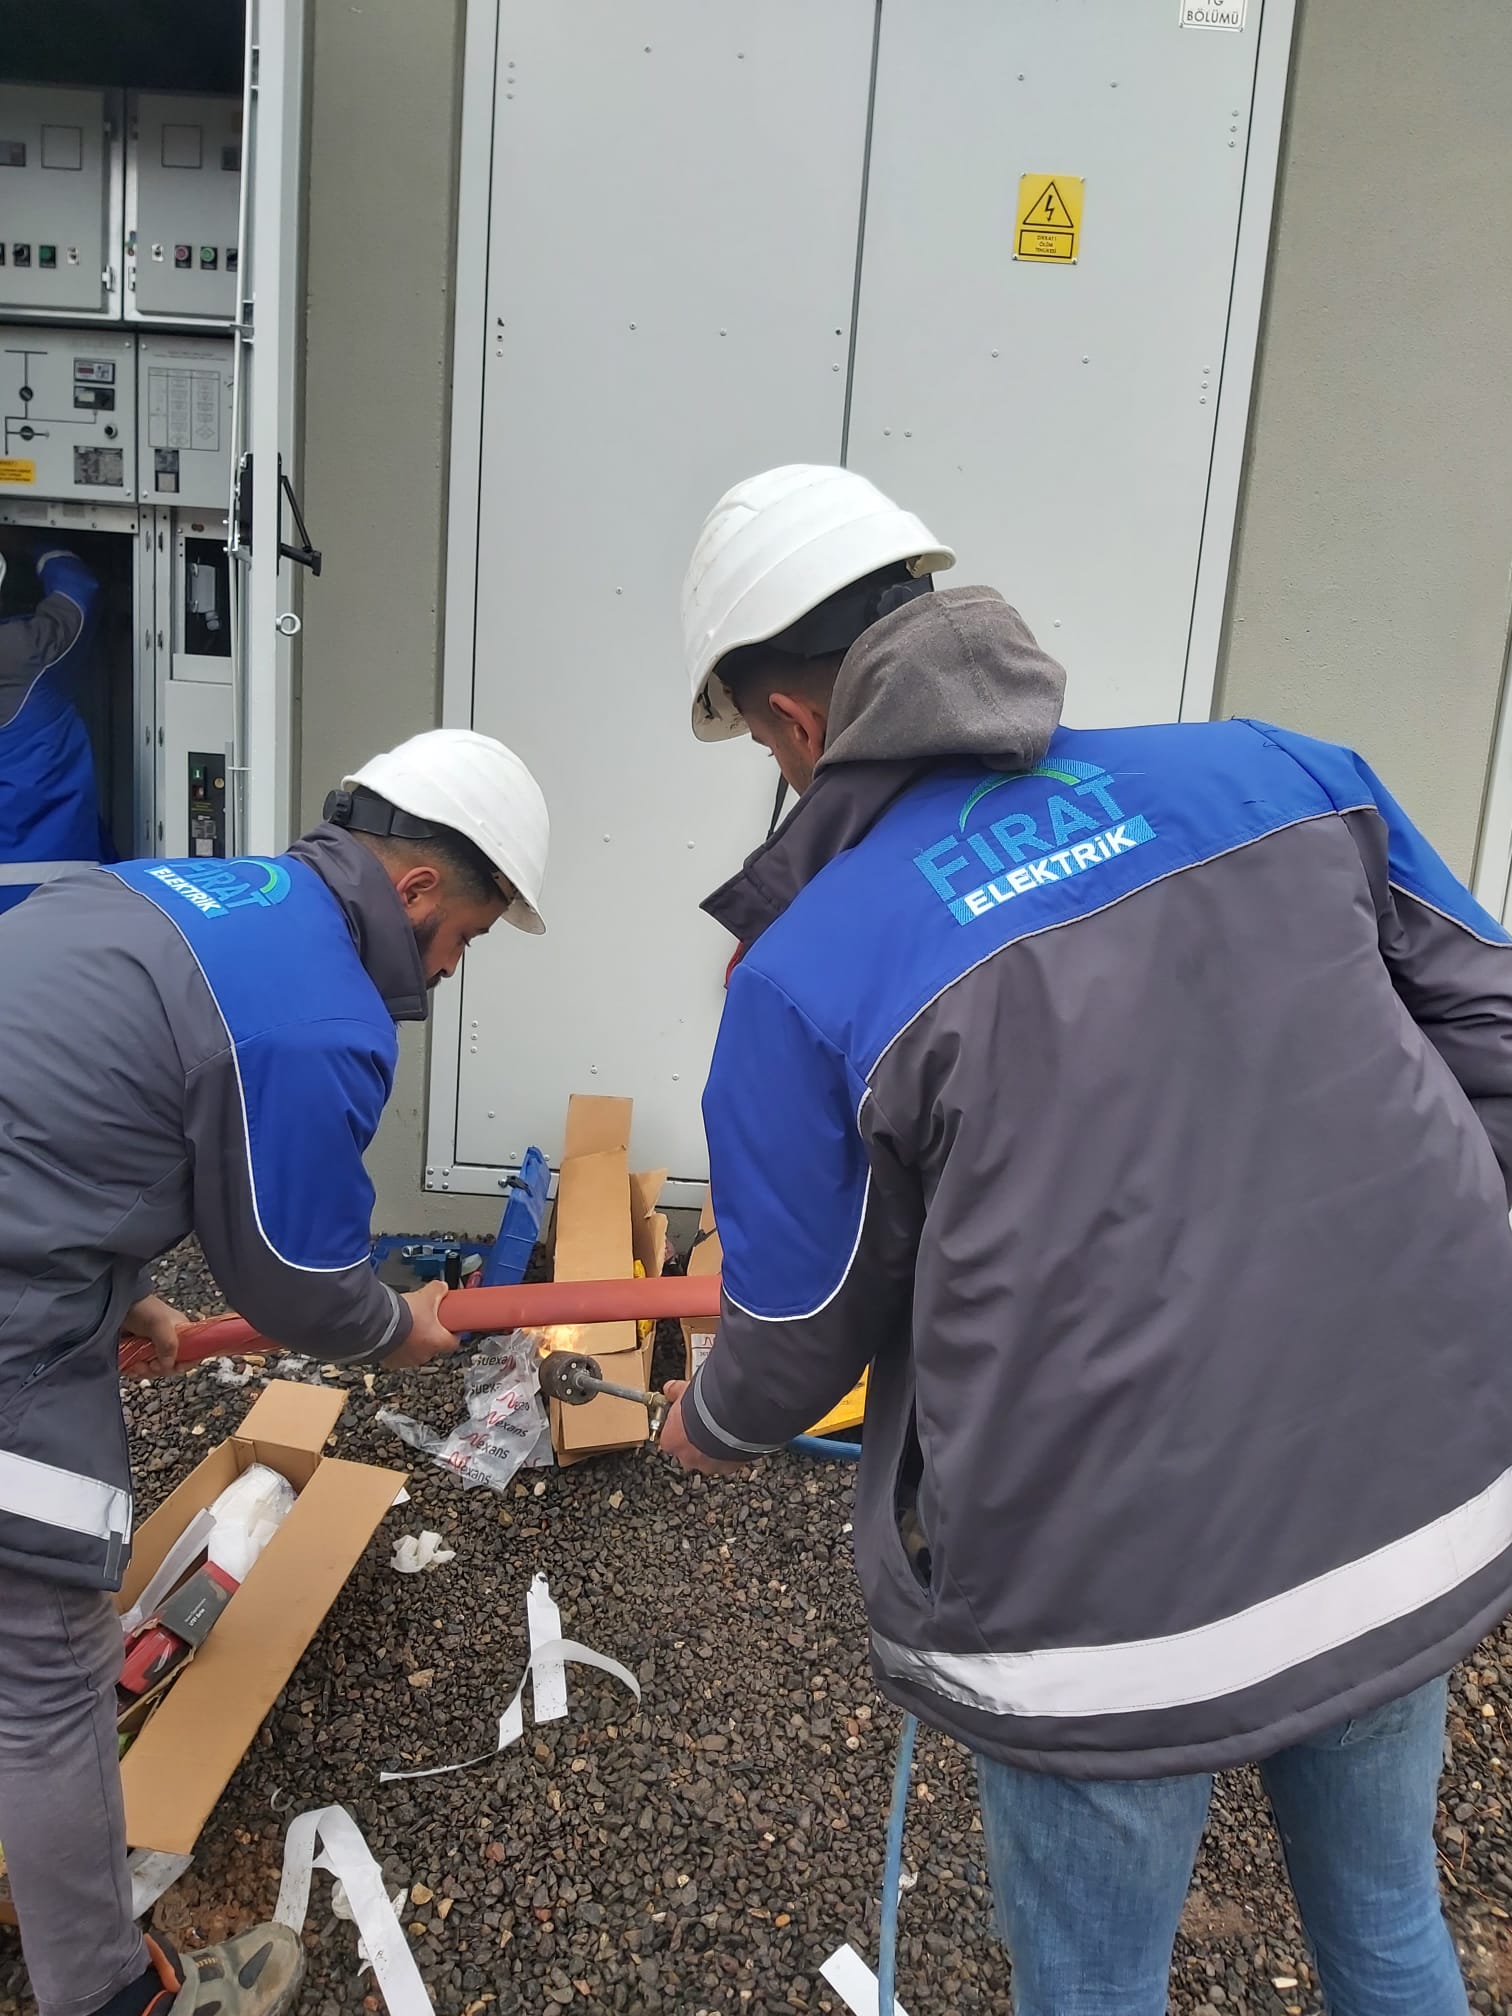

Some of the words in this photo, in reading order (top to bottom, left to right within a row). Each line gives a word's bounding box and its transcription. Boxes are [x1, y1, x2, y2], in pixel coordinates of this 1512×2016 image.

[1186, 8, 1239, 25] BÖLÜMÜ
[913, 774, 1125, 903] FIRAT
[167, 859, 271, 908] FIRAT
[478, 1410, 528, 1437] Nexans
[459, 1432, 510, 1459] Nexans
